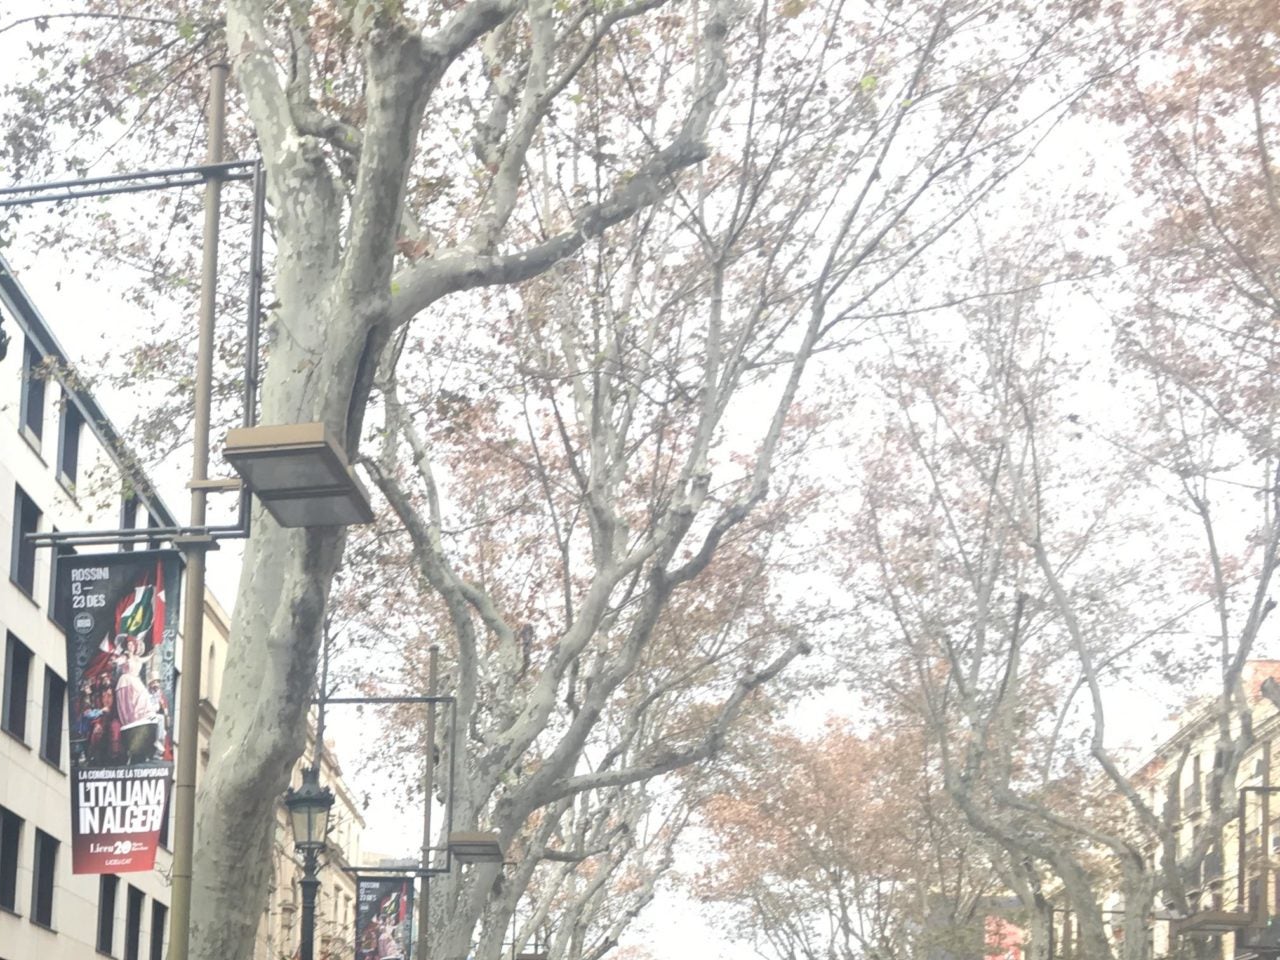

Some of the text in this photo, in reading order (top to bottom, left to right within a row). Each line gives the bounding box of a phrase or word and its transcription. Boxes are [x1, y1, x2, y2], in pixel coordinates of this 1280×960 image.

[71, 567, 109, 581] ROSSINI
[72, 594, 106, 608] 23 DES
[79, 804, 164, 834] IN ALGERI
